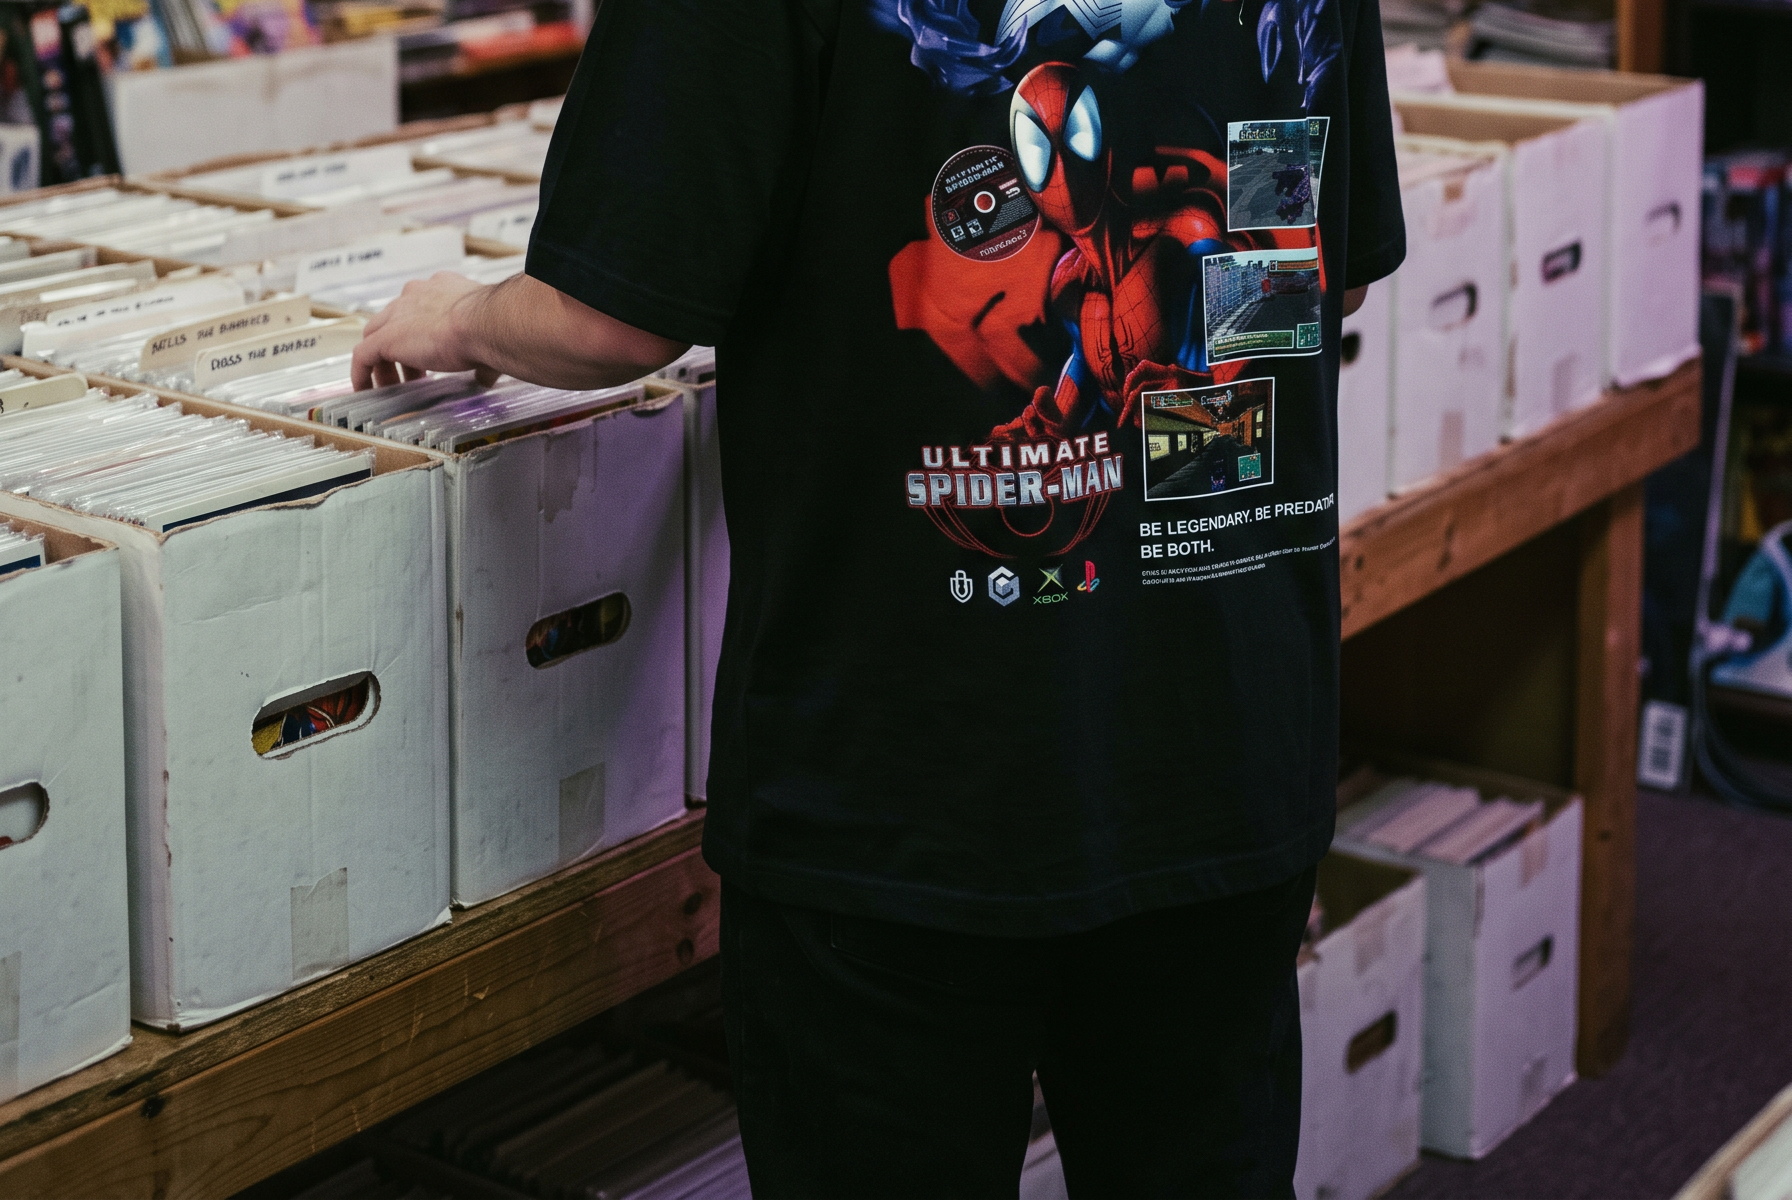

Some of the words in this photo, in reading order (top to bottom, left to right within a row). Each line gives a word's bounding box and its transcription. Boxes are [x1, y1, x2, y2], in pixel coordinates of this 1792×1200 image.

[921, 432, 1109, 468] ULTIMATE
[907, 455, 1123, 506] SPIDER-MAN
[1140, 522, 1162, 537] BE
[1167, 509, 1253, 535] LEGENDARY.
[1255, 506, 1272, 521] BE
[1140, 544, 1163, 559] BE
[1167, 539, 1215, 557] BOTH.
[1033, 591, 1069, 605] XBOX
